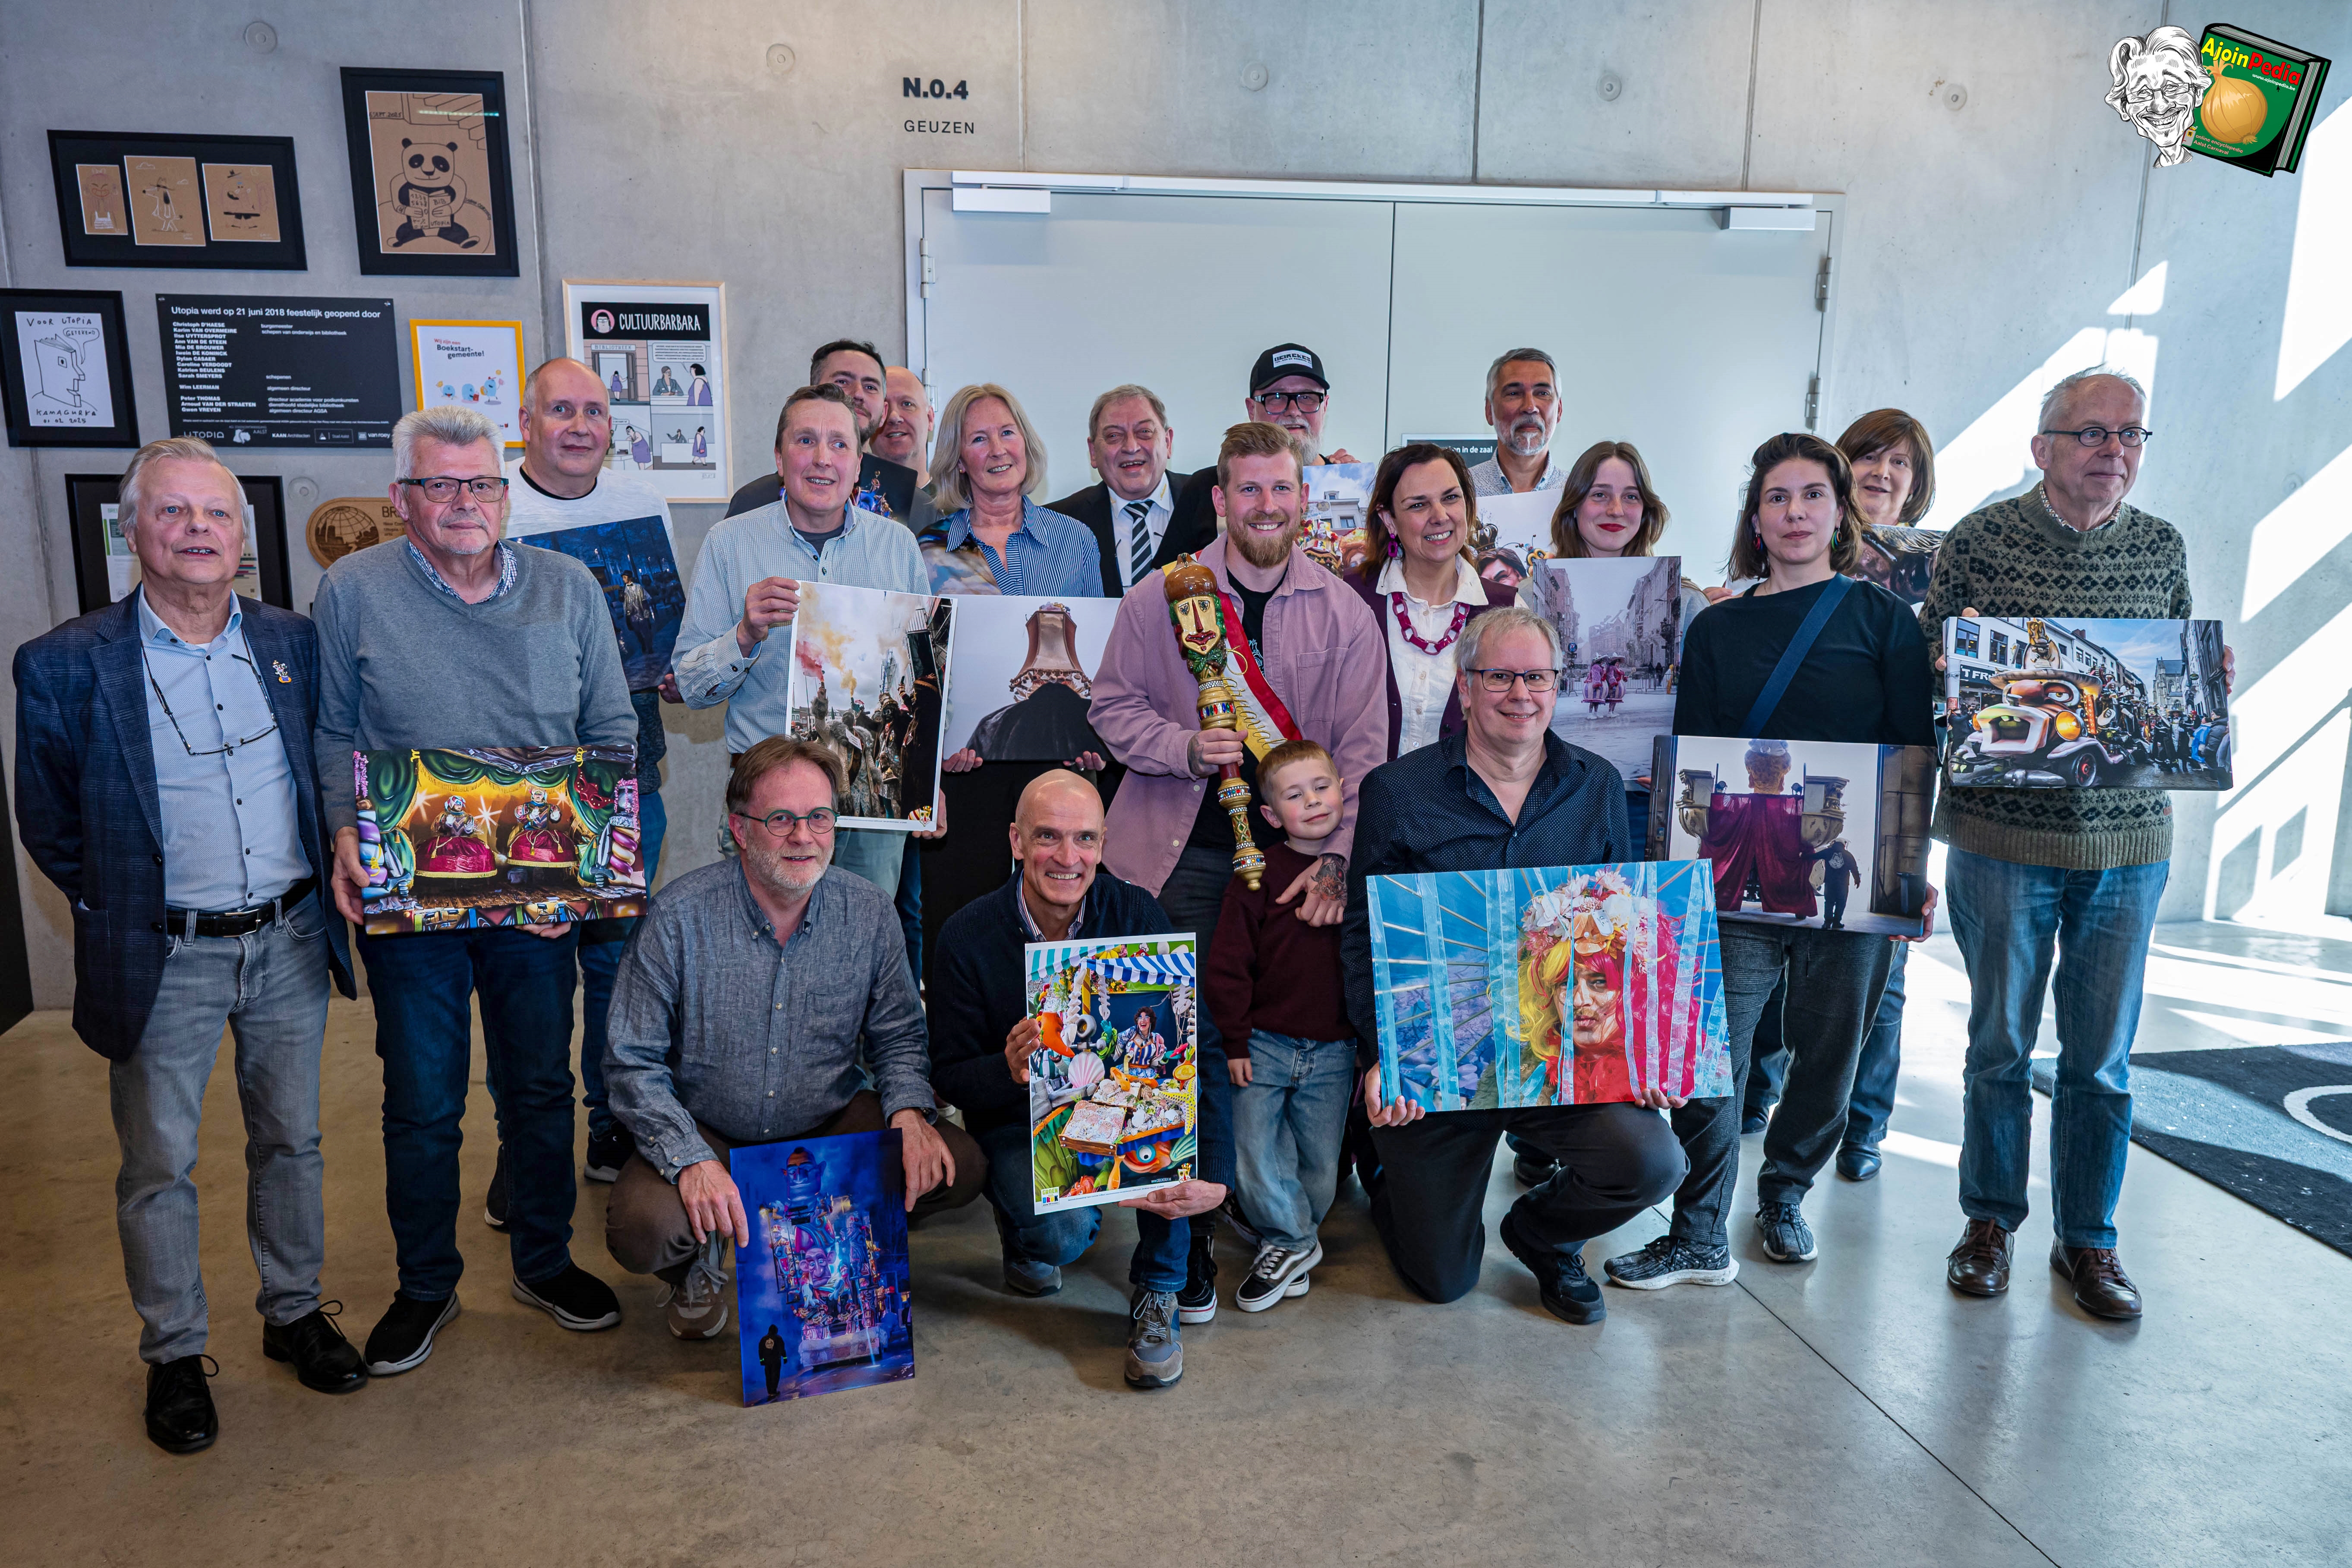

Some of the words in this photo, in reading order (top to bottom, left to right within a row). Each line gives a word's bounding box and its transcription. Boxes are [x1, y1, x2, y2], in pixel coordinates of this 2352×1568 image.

[904, 120, 974, 134] GEUZEN
[171, 306, 199, 315] Utopia
[201, 307, 221, 315] werd
[248, 308, 263, 317] juni
[287, 309, 322, 318] feestelijk
[324, 309, 360, 319] geopend
[27, 318, 54, 327] VOOR
[619, 313, 701, 331] CULTUURBARBARA
[448, 351, 484, 360] gemeente!
